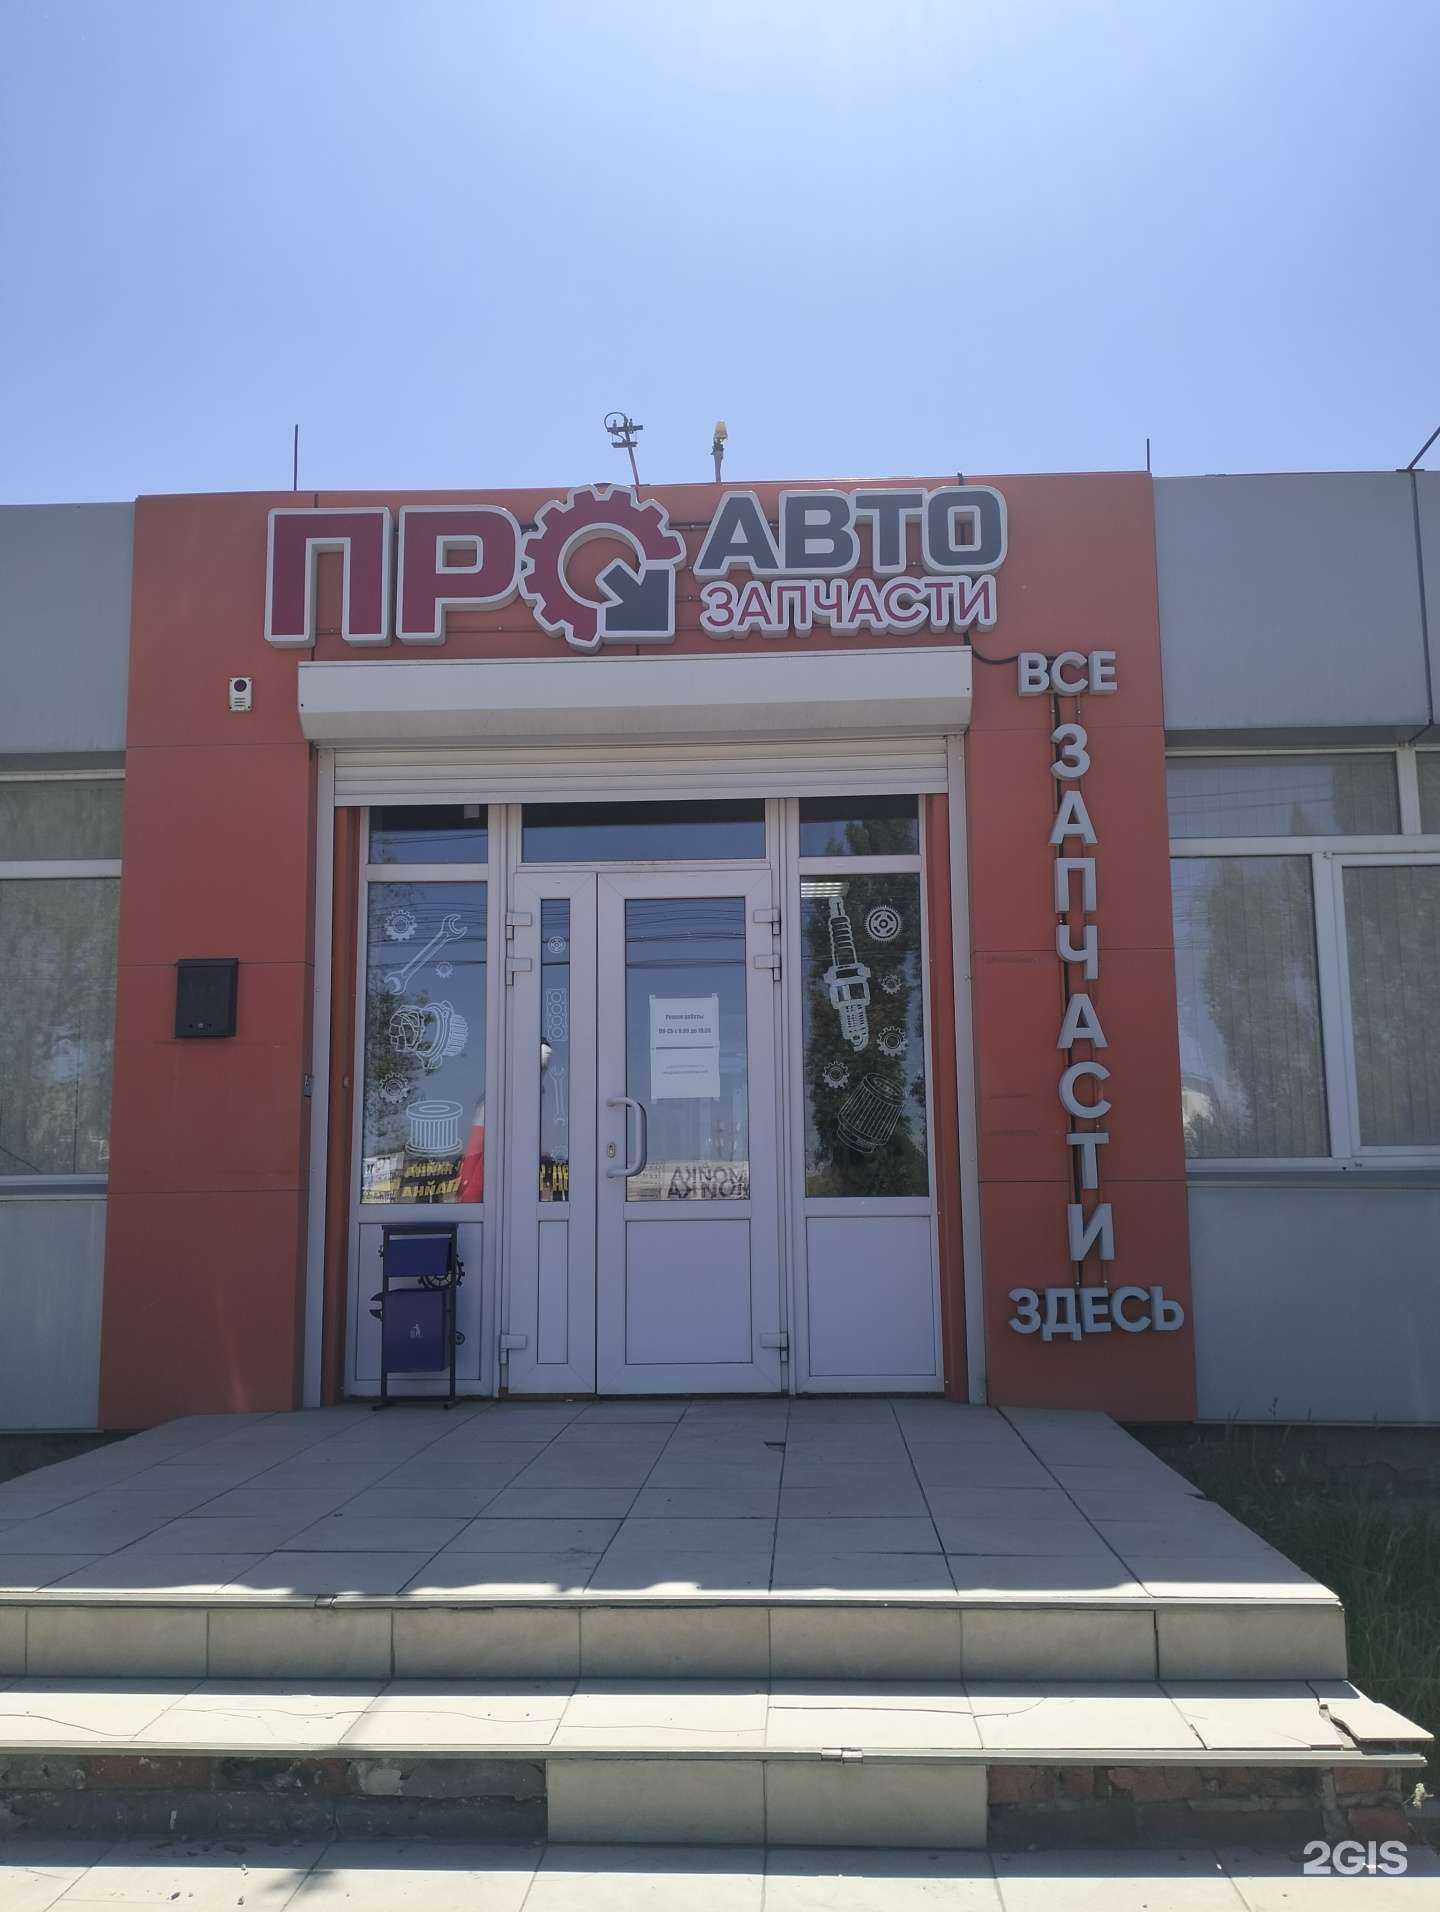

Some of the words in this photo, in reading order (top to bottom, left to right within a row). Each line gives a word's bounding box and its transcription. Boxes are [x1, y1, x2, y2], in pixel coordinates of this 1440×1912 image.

[693, 484, 1009, 577] АВТО
[699, 574, 998, 639] ЗАПЧАСТИ
[1017, 650, 1118, 697] ВСЕ
[1048, 723, 1116, 1262] ЗАПЧАСТИ
[1008, 1286, 1185, 1343] ЗДЕСЬ
